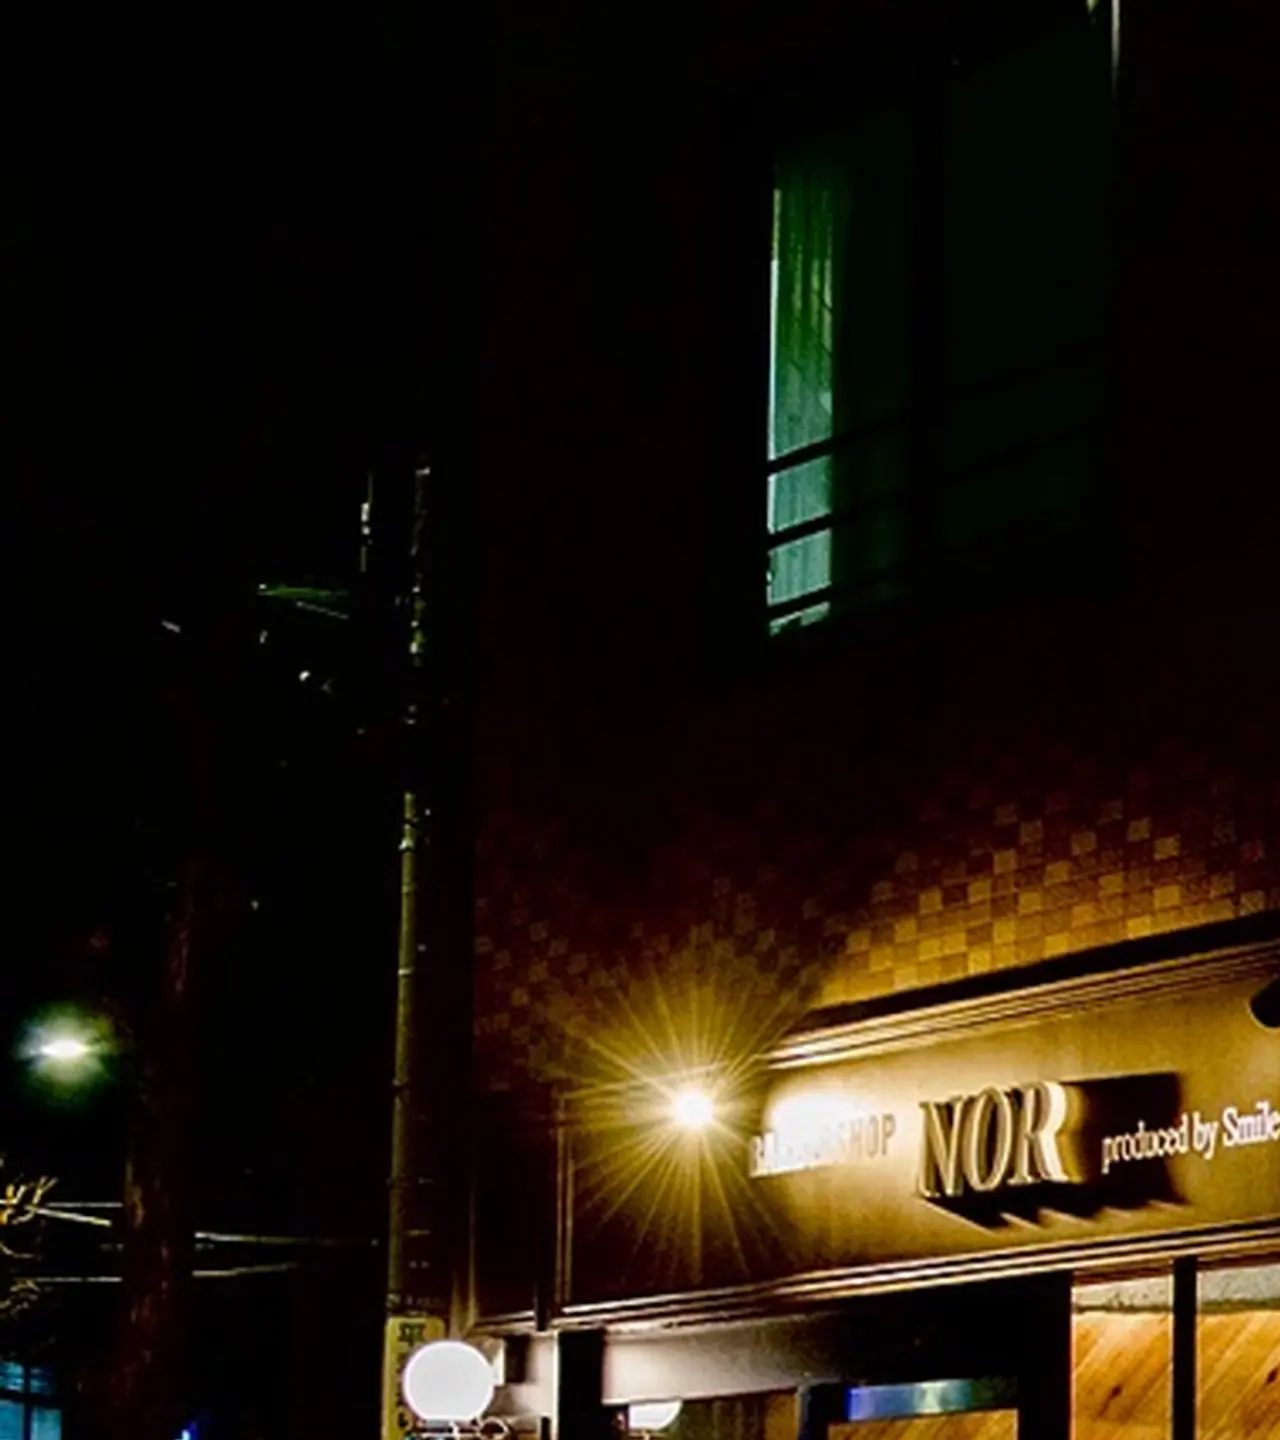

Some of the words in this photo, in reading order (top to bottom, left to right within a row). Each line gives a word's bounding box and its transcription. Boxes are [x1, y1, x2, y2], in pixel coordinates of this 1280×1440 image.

[917, 1080, 1084, 1199] NOR
[1101, 1110, 1190, 1175] produced
[1192, 1110, 1219, 1161] by
